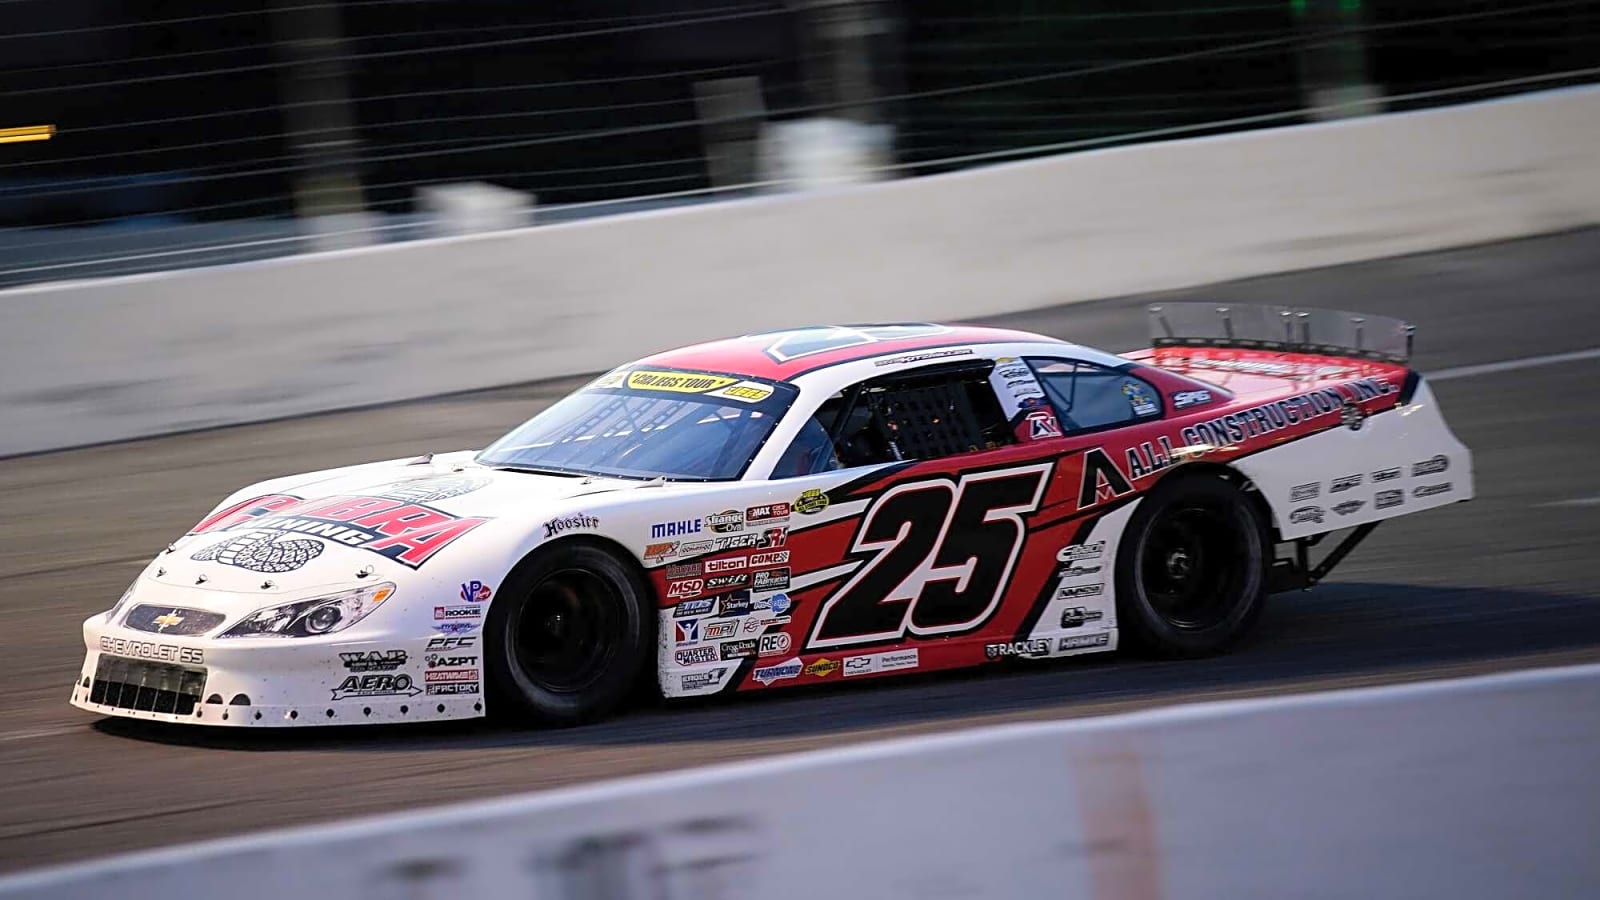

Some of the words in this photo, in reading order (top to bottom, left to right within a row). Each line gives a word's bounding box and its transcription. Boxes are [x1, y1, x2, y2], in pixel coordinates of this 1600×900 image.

[653, 377, 681, 388] JEGS
[681, 379, 717, 389] TOUR
[192, 494, 490, 569] CBRA
[542, 512, 599, 539] Hoosier
[652, 518, 701, 538] MAHLE
[806, 462, 1054, 649] 25
[707, 560, 744, 571] tilton
[461, 580, 482, 602] VP
[668, 580, 703, 595] MSD
[445, 608, 481, 617] ROOKIE
[726, 601, 749, 610] Starkey
[427, 636, 477, 648] PFC
[998, 638, 1052, 656] RACKLEY
[100, 635, 179, 662] CHEVROLET
[180, 647, 204, 665] SS
[437, 656, 478, 667] AZPT
[683, 653, 718, 665] MASTER
[806, 661, 840, 674] SUNOCO
[338, 674, 413, 692] AERO
[434, 684, 479, 693] FACTORY
